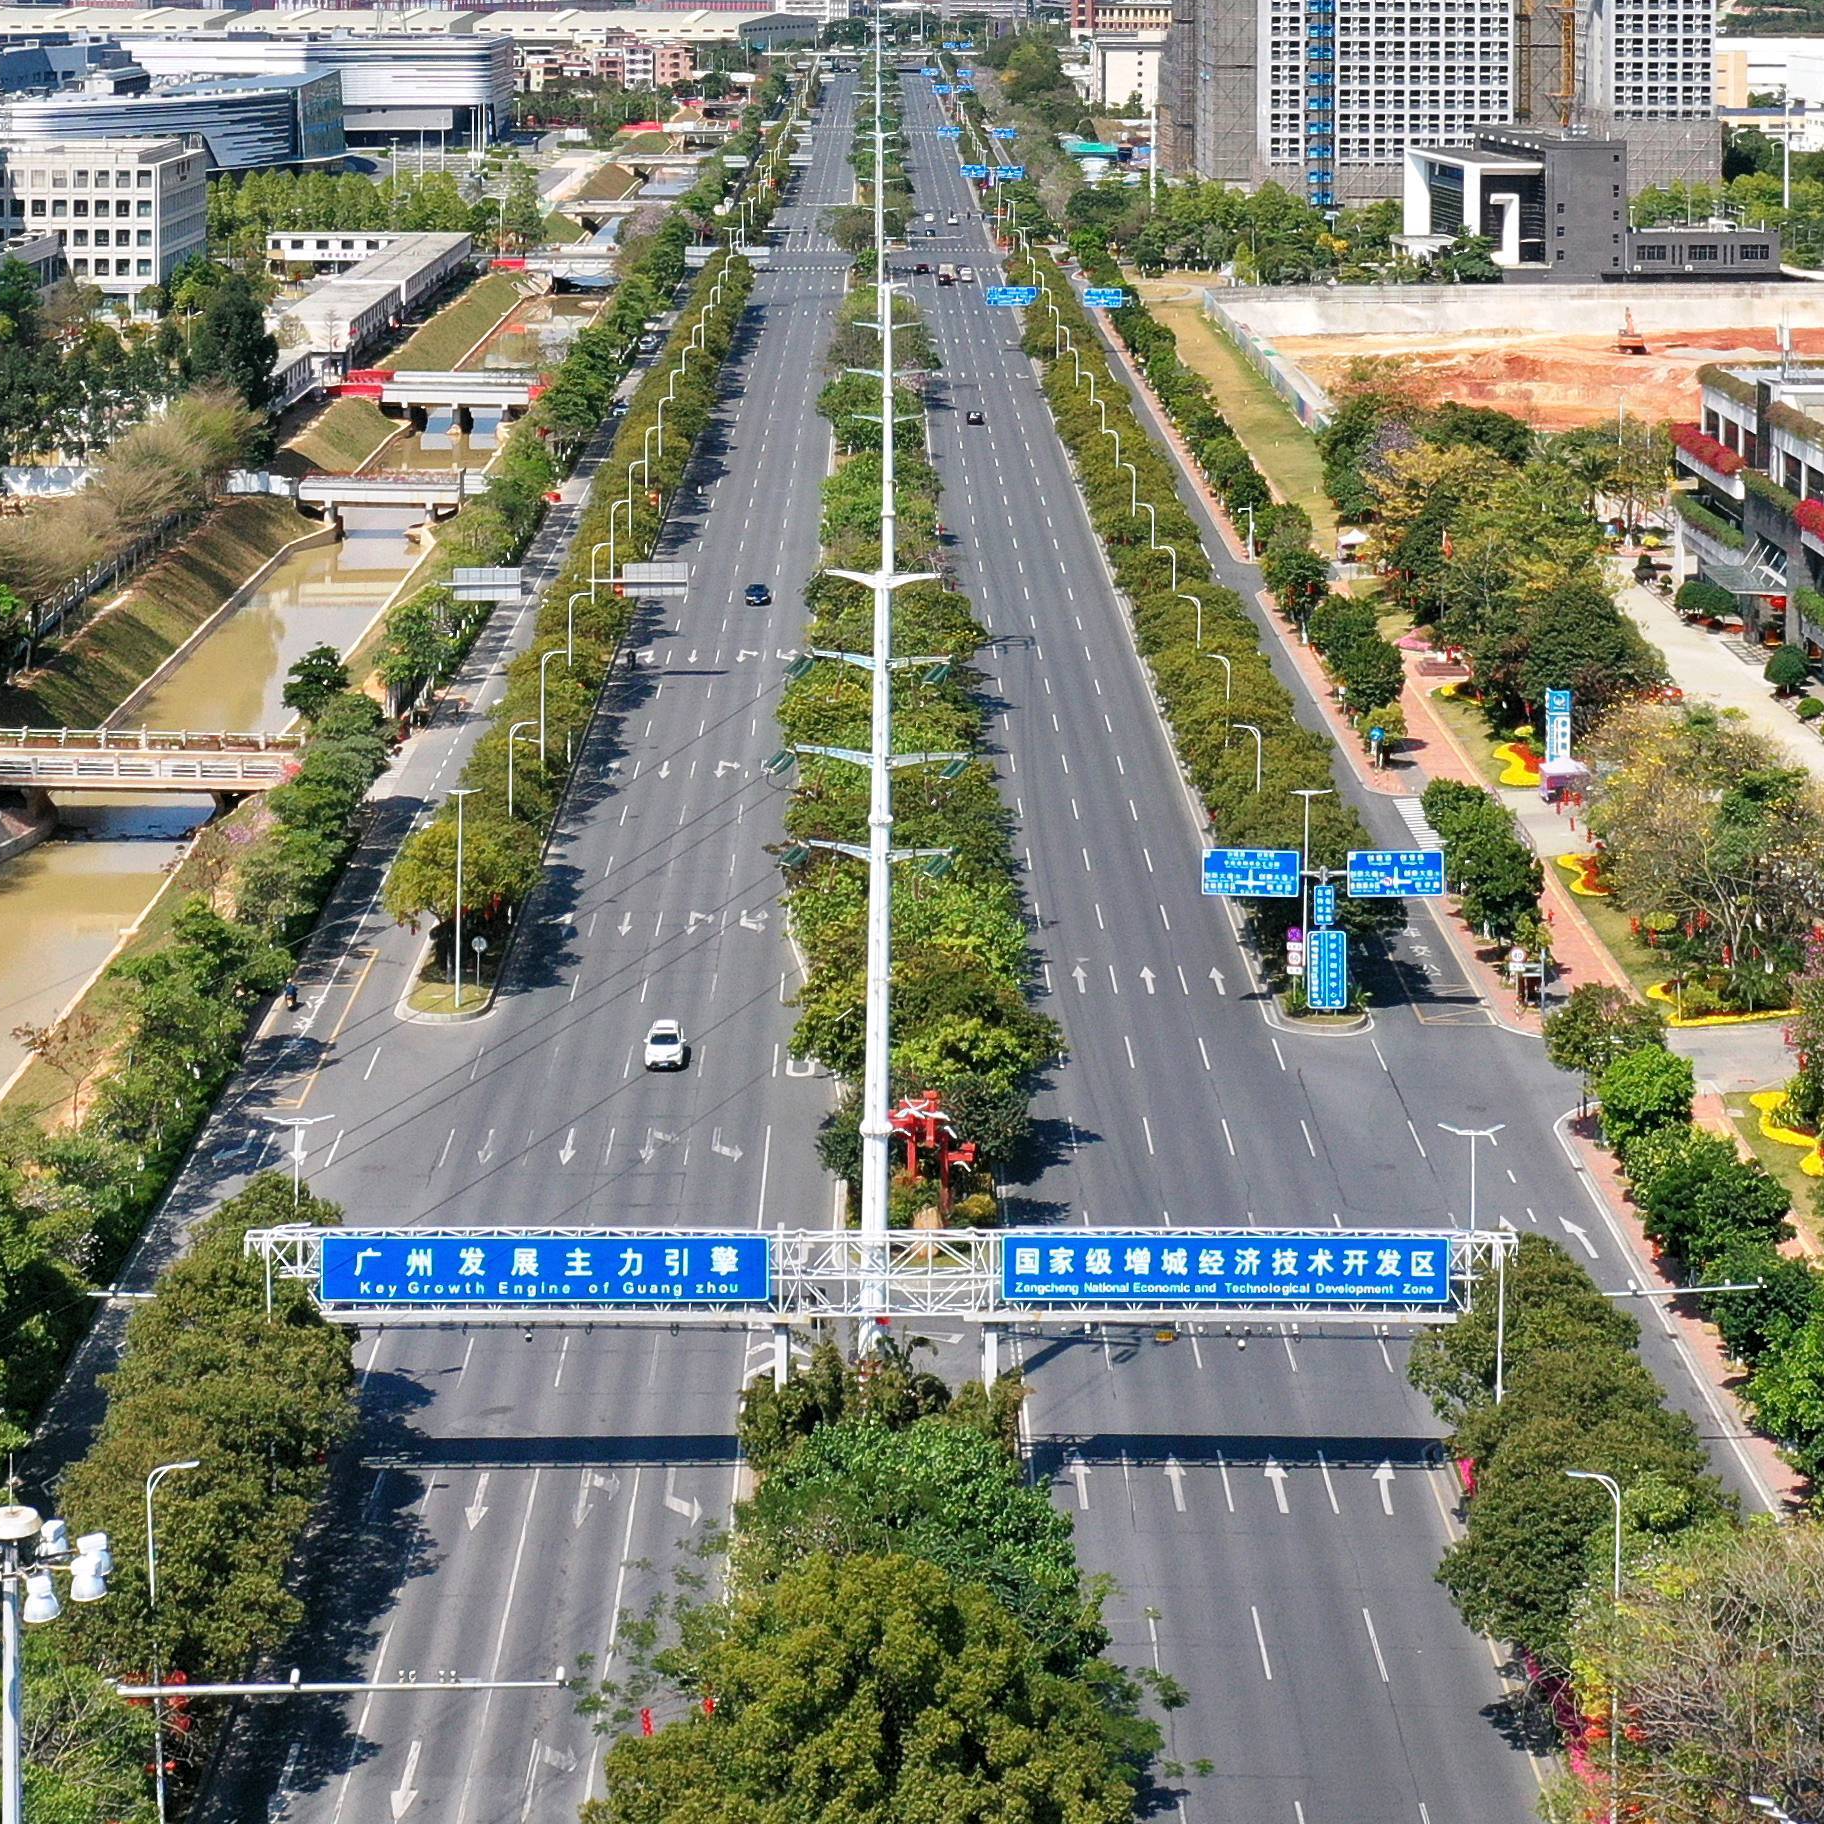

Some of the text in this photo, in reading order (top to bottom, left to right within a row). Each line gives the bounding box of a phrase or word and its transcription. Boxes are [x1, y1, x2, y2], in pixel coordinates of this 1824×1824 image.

[354, 1247, 739, 1277] 广州发展主力引擎
[1015, 1247, 1436, 1276] 国家级增城经济技术开发区
[360, 1281, 739, 1297] Key Growth Engine of Guang zhou
[1084, 1281, 1129, 1293] National
[1133, 1281, 1190, 1294] Economic
[1194, 1282, 1216, 1294] and
[1224, 1282, 1310, 1296] Technological
[1315, 1282, 1394, 1296] Development
[1402, 1283, 1434, 1295] Zone
